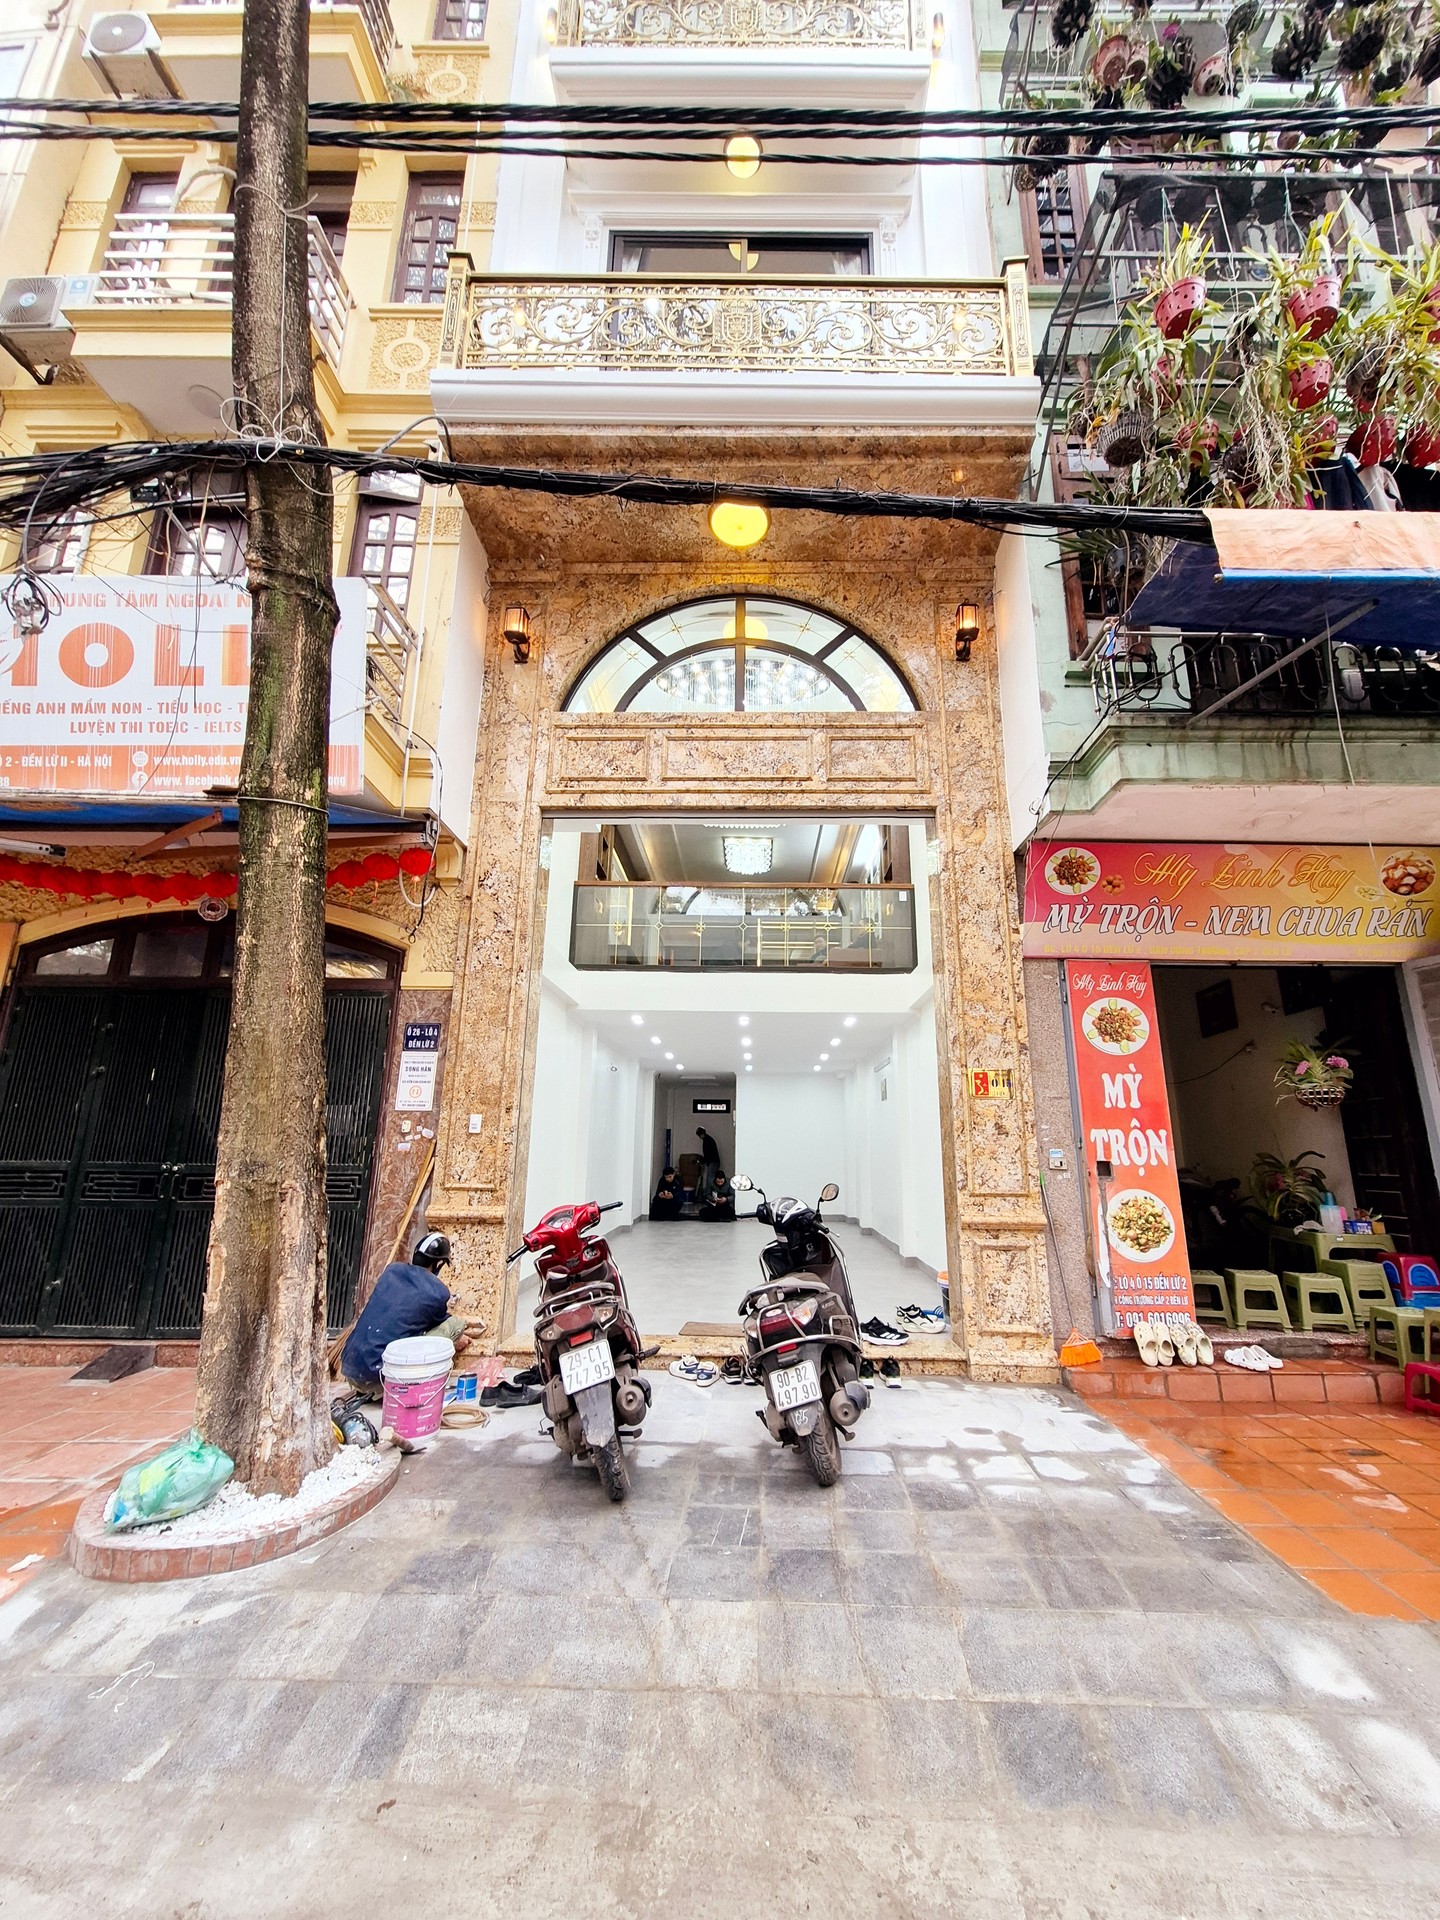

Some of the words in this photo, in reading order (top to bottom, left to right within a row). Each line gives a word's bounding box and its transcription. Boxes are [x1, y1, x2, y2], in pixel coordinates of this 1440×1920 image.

[0, 698, 31, 714] ẾNG
[36, 702, 66, 715] ANH
[111, 702, 143, 715] NON
[193, 702, 222, 717] HỌC
[70, 718, 116, 737] LUYỆN
[120, 721, 143, 734] THI
[148, 721, 189, 734] TOEIC
[204, 721, 242, 734] IELTS
[5, 756, 12, 767] 2
[153, 754, 242, 767] www.holly.edu.vn
[1201, 847, 1300, 889] Linh
[1287, 853, 1356, 904] Huy
[1043, 896, 1094, 933] MỲ
[1099, 896, 1183, 942] TRỘN
[1203, 905, 1271, 935] NEM
[1277, 906, 1363, 937] CHUA
[1366, 899, 1434, 938] RÁN
[1096, 971, 1127, 992] Linh
[1125, 974, 1147, 999] Huy
[1101, 1063, 1143, 1109] MỲ
[1090, 1117, 1169, 1177] TRỘN
[1130, 1276, 1135, 1290] 4
[1143, 1276, 1153, 1290] 15
[1181, 1276, 1187, 1290] 2
[567, 1345, 602, 1372] 29-C1
[566, 1361, 611, 1391] 747.95
[776, 1365, 809, 1389] 90-B2
[777, 1381, 818, 1408] 497.90
